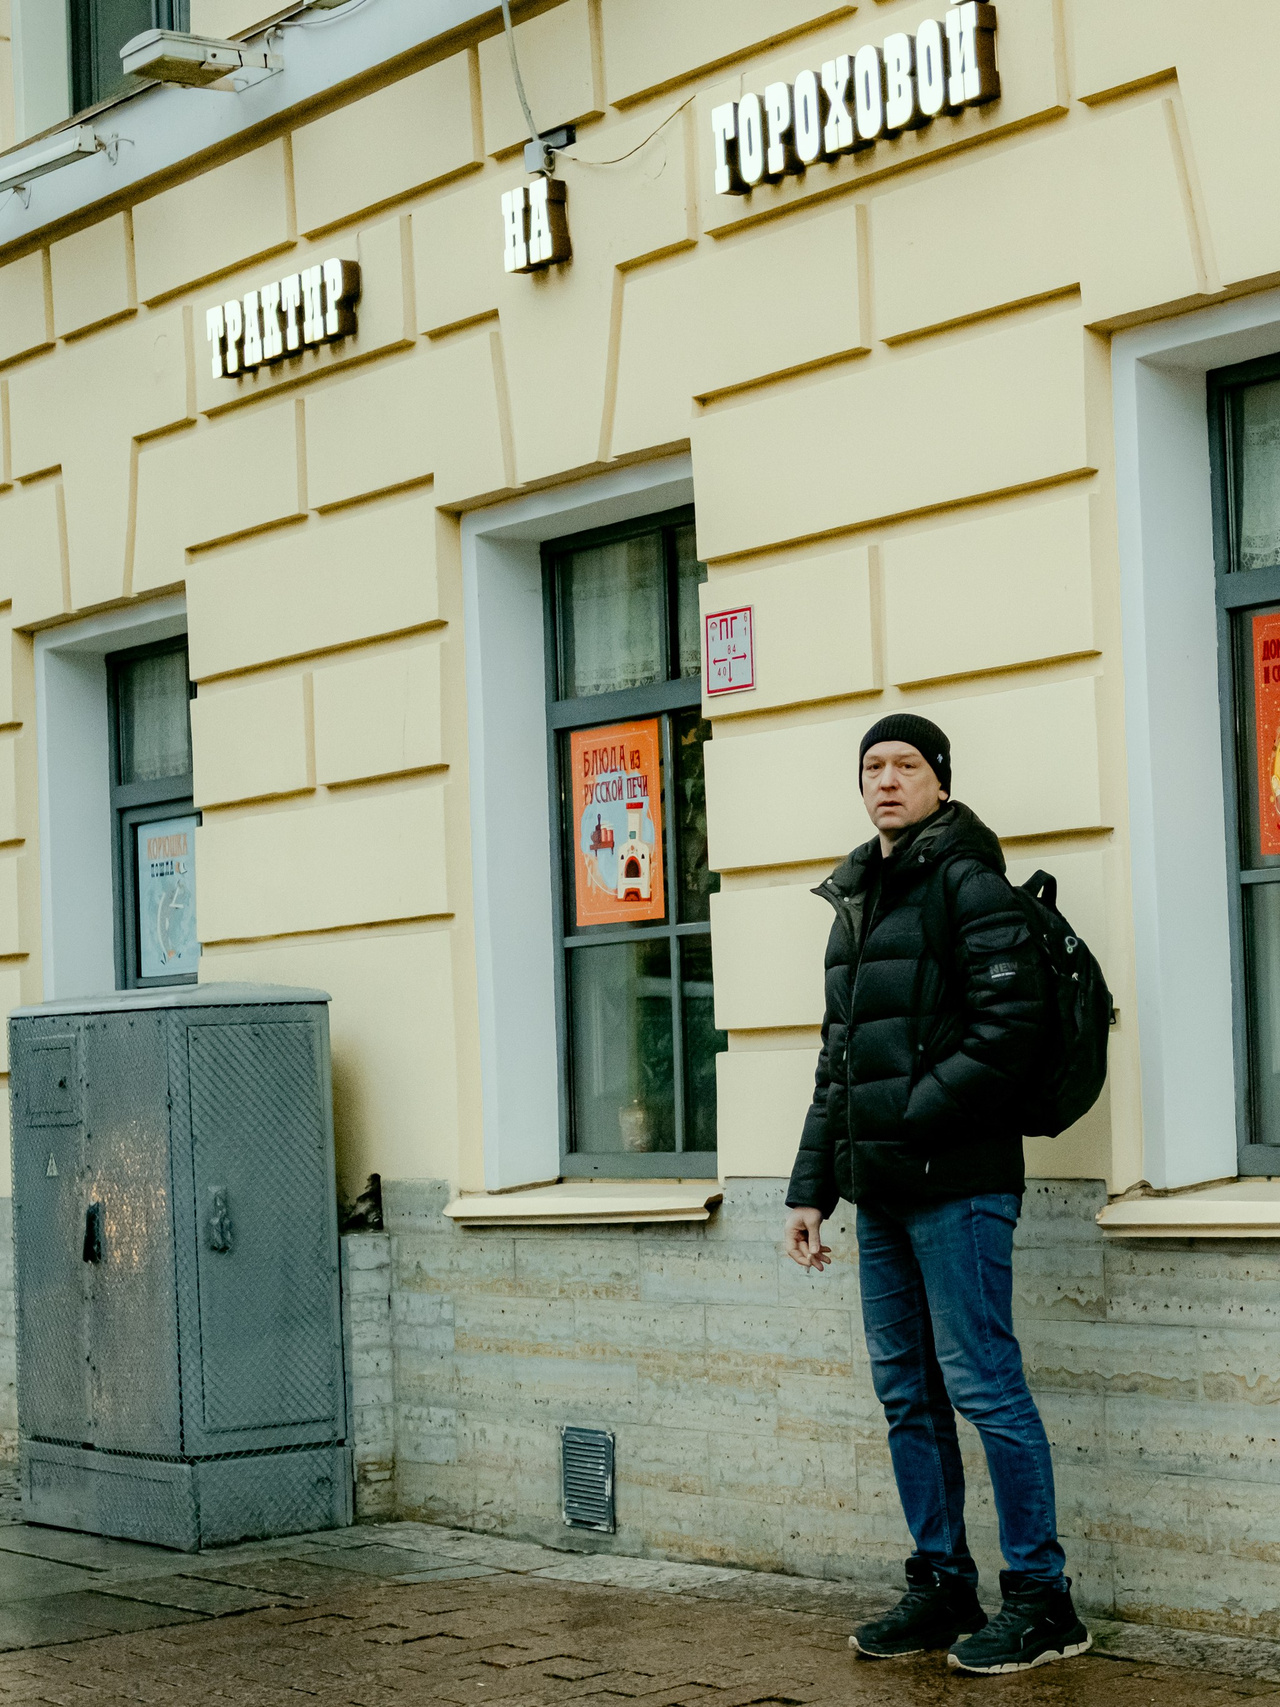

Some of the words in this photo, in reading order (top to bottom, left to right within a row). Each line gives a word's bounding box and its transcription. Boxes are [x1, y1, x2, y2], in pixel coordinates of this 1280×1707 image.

[206, 258, 345, 379] ТРАКТИР
[501, 176, 556, 273] НА
[711, 0, 982, 194] ГОРОХОВОЙ
[720, 616, 737, 640] ПГ
[1263, 666, 1270, 684] И
[583, 745, 627, 778] БЛЮДА
[584, 776, 624, 805] РУССКОЙ
[626, 775, 648, 799] ПЕЧИ
[146, 832, 188, 860] КОРЮШКА
[990, 962, 1018, 975] NEW
